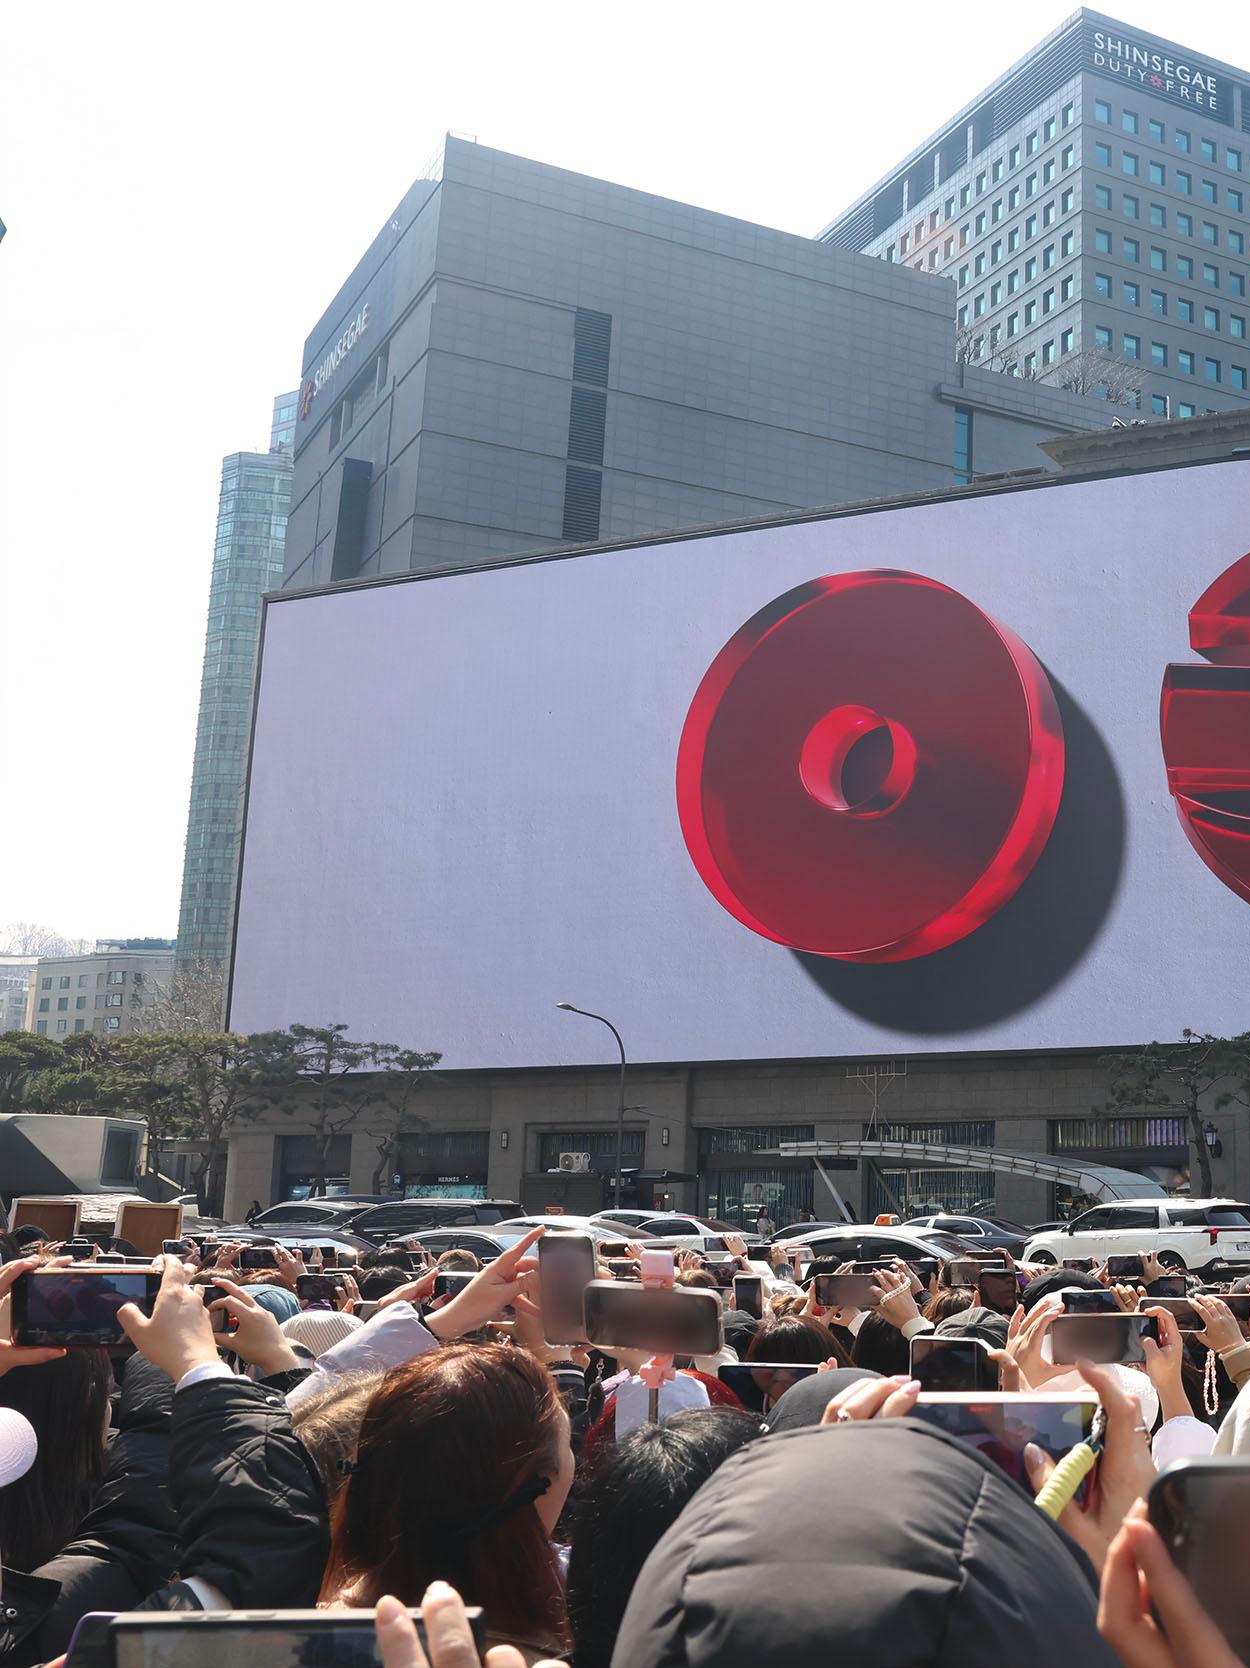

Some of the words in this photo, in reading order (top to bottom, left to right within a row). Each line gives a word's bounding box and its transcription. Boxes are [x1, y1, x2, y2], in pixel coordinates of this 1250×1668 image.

[1094, 32, 1217, 94] SHINSEGAE
[1094, 52, 1147, 83] DUTY
[1166, 79, 1217, 110] FREE
[313, 302, 369, 397] SHINSEGAE
